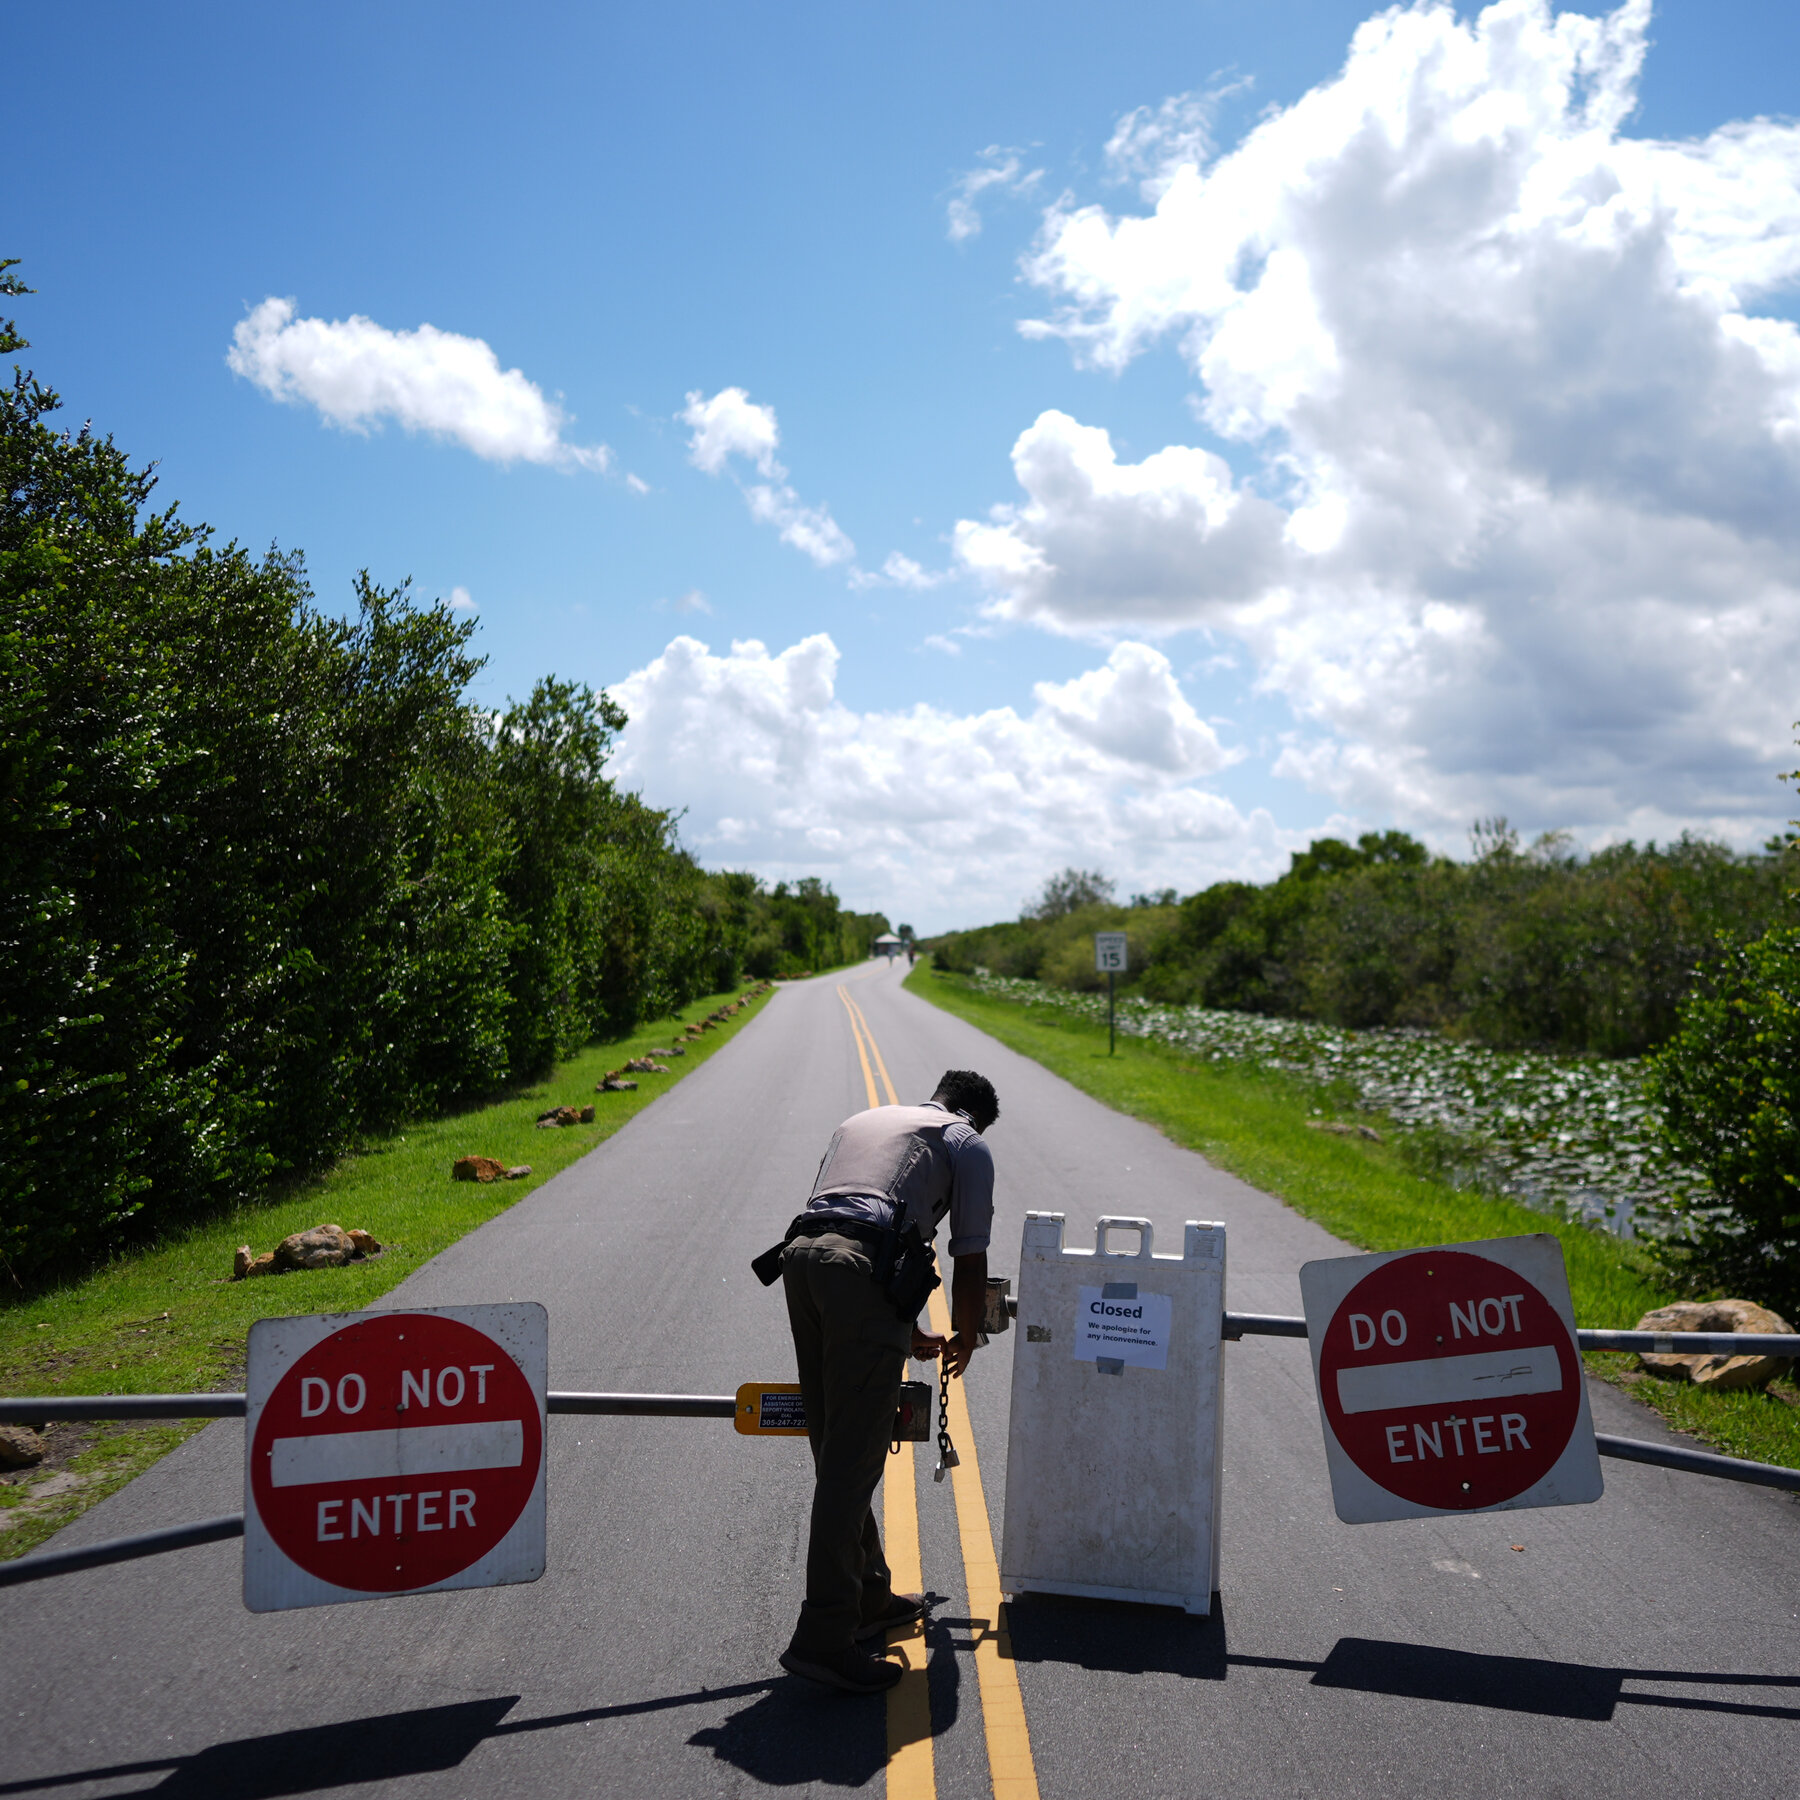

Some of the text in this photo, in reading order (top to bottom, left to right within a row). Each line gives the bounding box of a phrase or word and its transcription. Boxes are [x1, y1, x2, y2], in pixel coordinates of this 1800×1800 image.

[1102, 952, 1121, 967] 15
[1090, 1302, 1143, 1319] Closed
[1348, 1294, 1524, 1351] DO NOT
[1087, 1333, 1158, 1347] any inconvenience.
[1101, 1324, 1138, 1334] apologize
[1139, 1327, 1151, 1335] for
[300, 1364, 495, 1418] DO NOT
[1385, 1412, 1532, 1464] ENTER
[317, 1488, 477, 1542] ENTER
